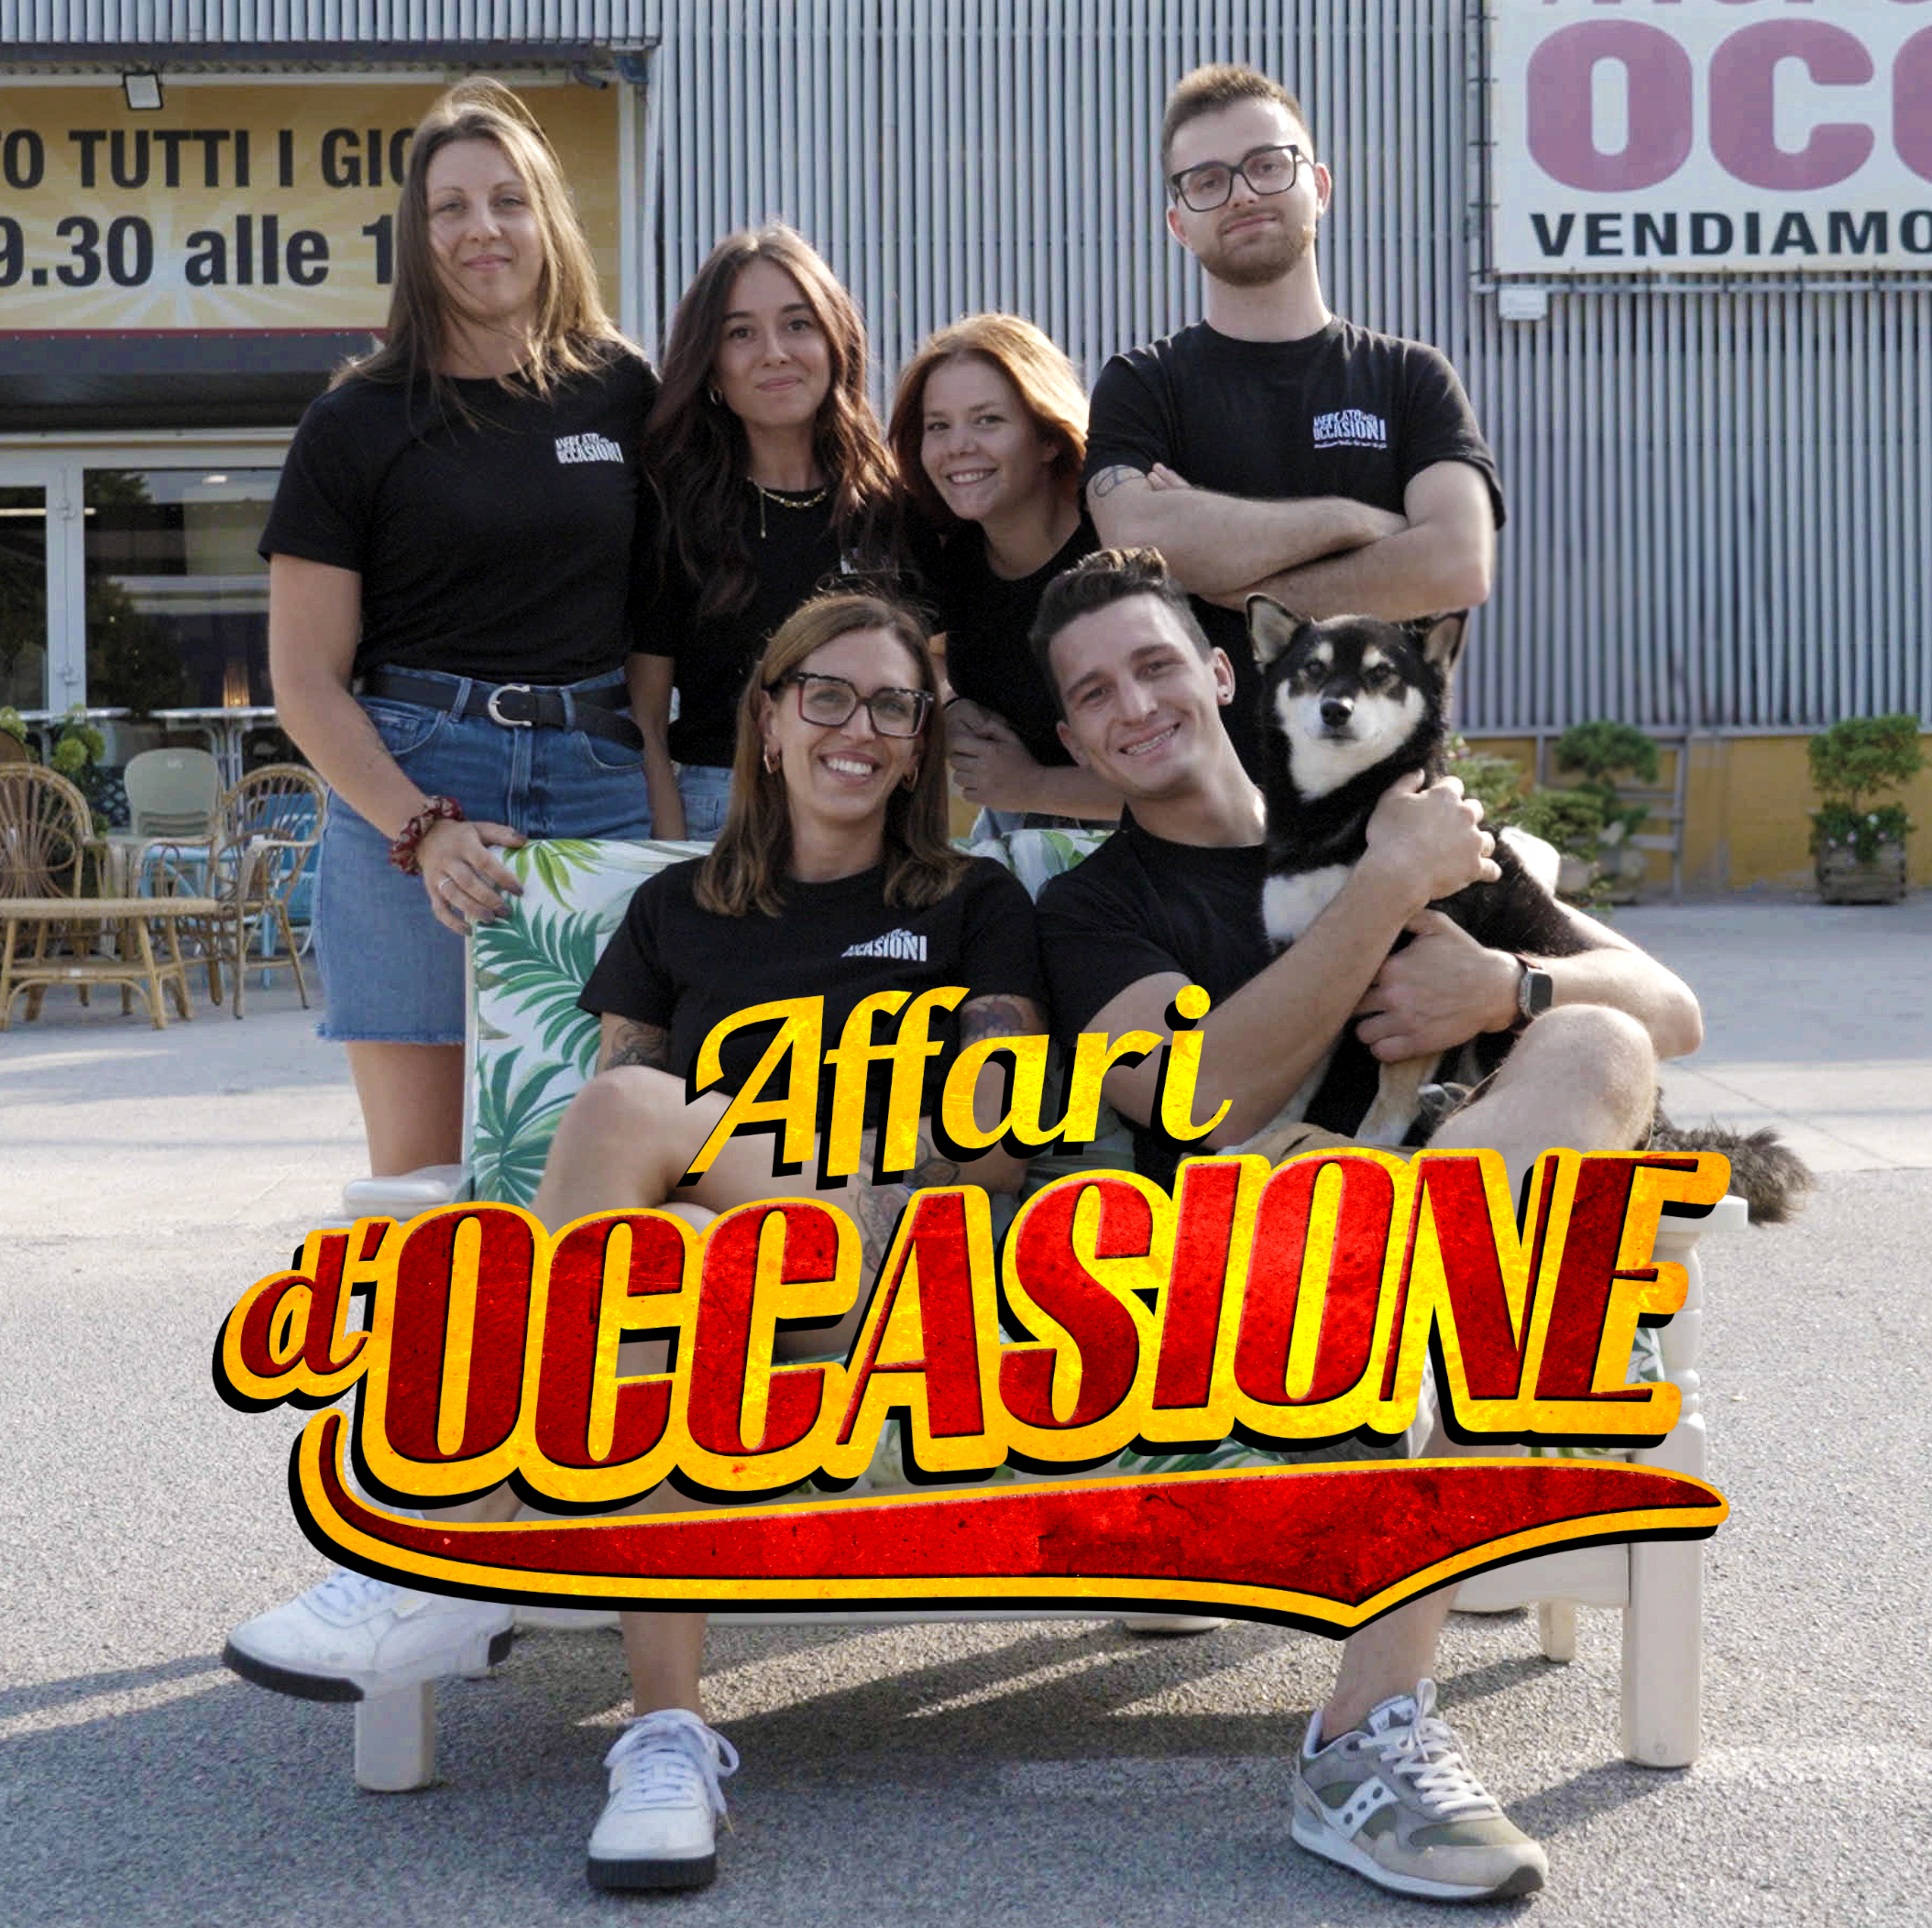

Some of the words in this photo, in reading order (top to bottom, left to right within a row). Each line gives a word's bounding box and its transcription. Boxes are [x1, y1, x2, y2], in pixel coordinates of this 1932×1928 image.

[1527, 18, 1932, 192] OC
[0, 129, 45, 189] O
[69, 129, 249, 189] TUTTI
[280, 129, 292, 188] I
[184, 214, 329, 286] alle
[1530, 210, 1932, 257] VENDIAMO
